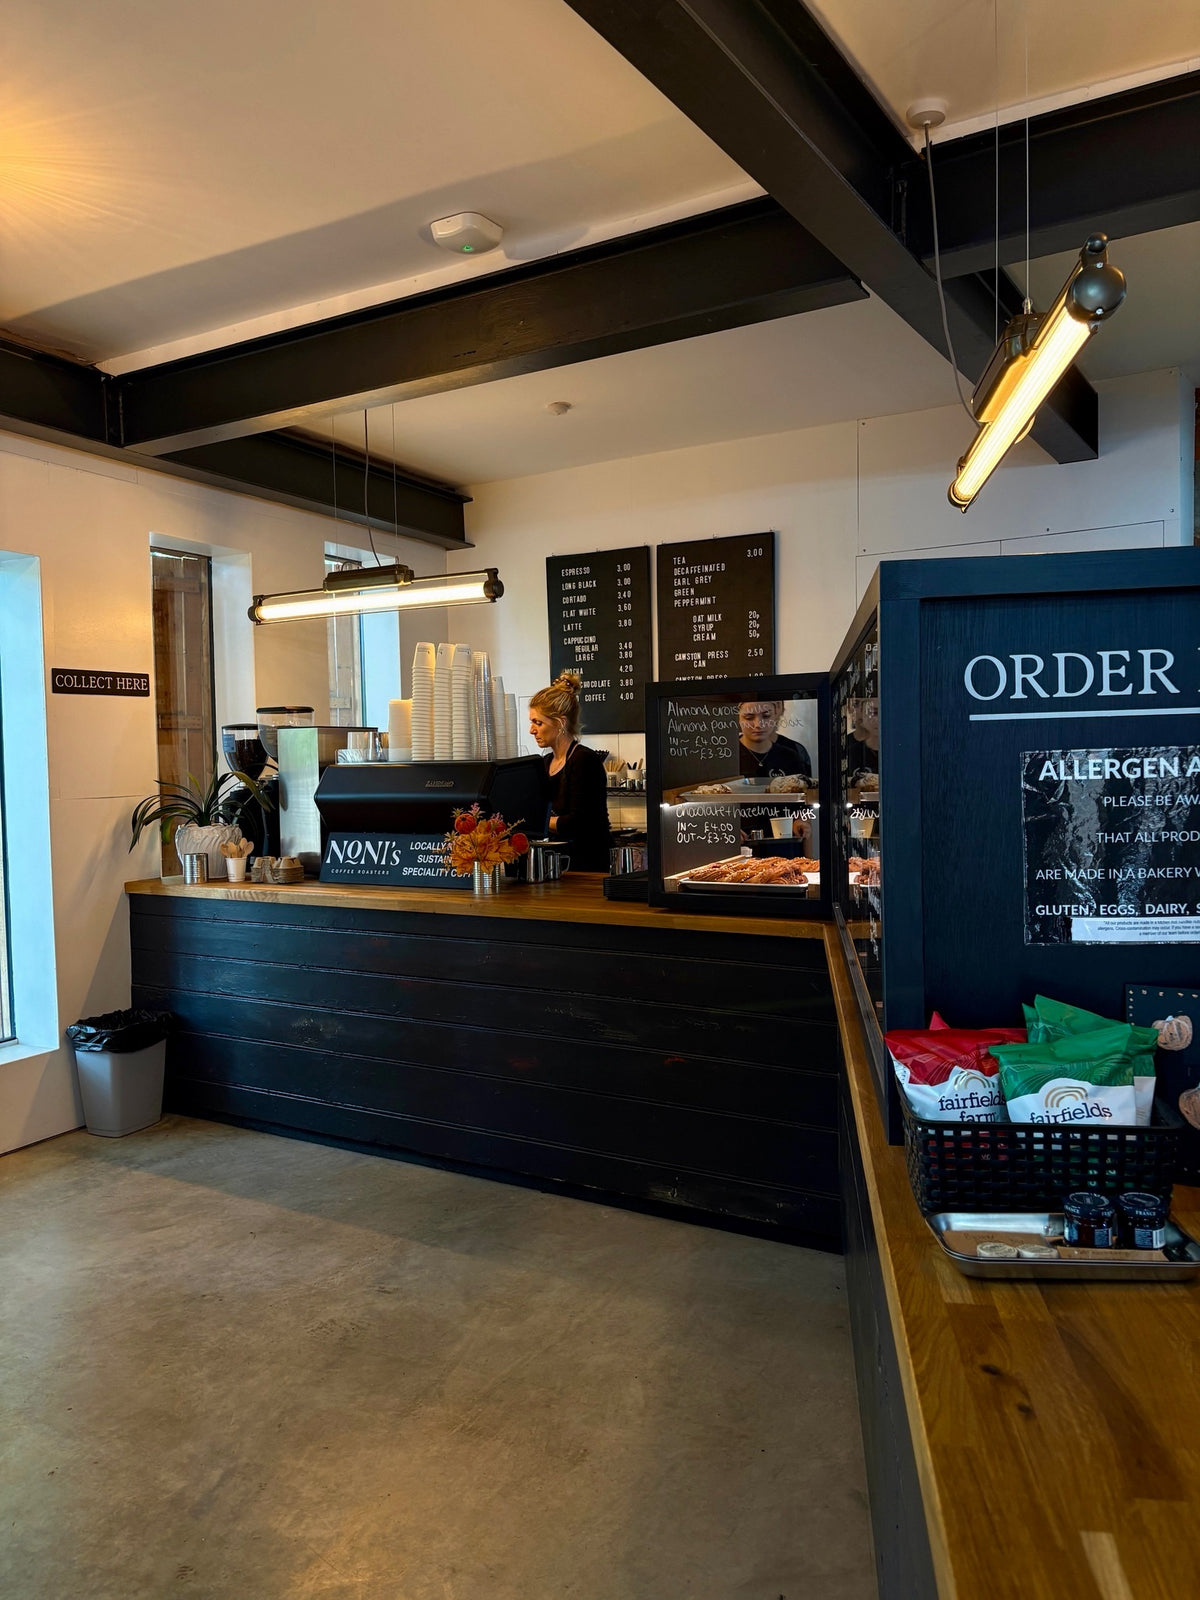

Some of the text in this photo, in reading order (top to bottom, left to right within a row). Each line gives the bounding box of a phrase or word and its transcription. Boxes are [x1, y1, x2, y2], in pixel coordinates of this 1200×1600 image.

[673, 548, 763, 565] TEA 3.00
[562, 566, 590, 576] ESPRESSO
[674, 562, 726, 576] DECAFFEINATED
[562, 582, 576, 590] LONG
[578, 580, 596, 589] BLACK
[674, 575, 712, 586] EARL GREY
[562, 590, 632, 604] CORTADO 3.40
[674, 588, 694, 597] GREEN
[674, 596, 716, 607] PEPPERMINT
[562, 609, 576, 618] FLAT
[578, 608, 596, 616] WHITE
[692, 614, 704, 623] OAT
[707, 614, 722, 622] MILK
[563, 618, 632, 632] LATTE 3.80
[692, 624, 714, 632] SYRUP
[564, 636, 596, 645] CAPPUCCINO
[693, 632, 716, 642] CREAM
[575, 642, 632, 652] REGULAR 3.40
[576, 650, 632, 662] LARGE 3.80
[675, 648, 764, 661] CAWSTON PRESS 2.50
[619, 664, 633, 672] 4.20
[694, 660, 706, 668] CAN
[964, 648, 1180, 700] ORDER
[56, 674, 148, 690] COLLECT HERE
[620, 678, 634, 687] 3.80
[584, 694, 606, 702] COFFEE
[620, 692, 634, 700] 4.00
[668, 701, 711, 716] Almond
[668, 718, 709, 734] Almond
[1038, 757, 1179, 780] ALLERGEN
[1104, 795, 1154, 807] PLEASE
[1156, 795, 1172, 806] BE
[704, 822, 734, 833] £4.00
[1096, 832, 1132, 843] THAT
[1135, 832, 1159, 843] ALL
[410, 842, 448, 850] LOCALLY
[402, 867, 450, 877] SPECIALITY
[1036, 868, 1062, 880] ARE
[1065, 868, 1105, 880] MADE
[1108, 868, 1122, 880] IN
[1126, 868, 1136, 880] A
[1139, 867, 1192, 878] BAKERY
[1035, 904, 1094, 916] GLUTEN,
[1100, 904, 1138, 916] EGGS,
[1145, 903, 1190, 916] DAIRY,
[938, 1090, 1006, 1112] fairfields
[1030, 1102, 1112, 1125] fairfields
